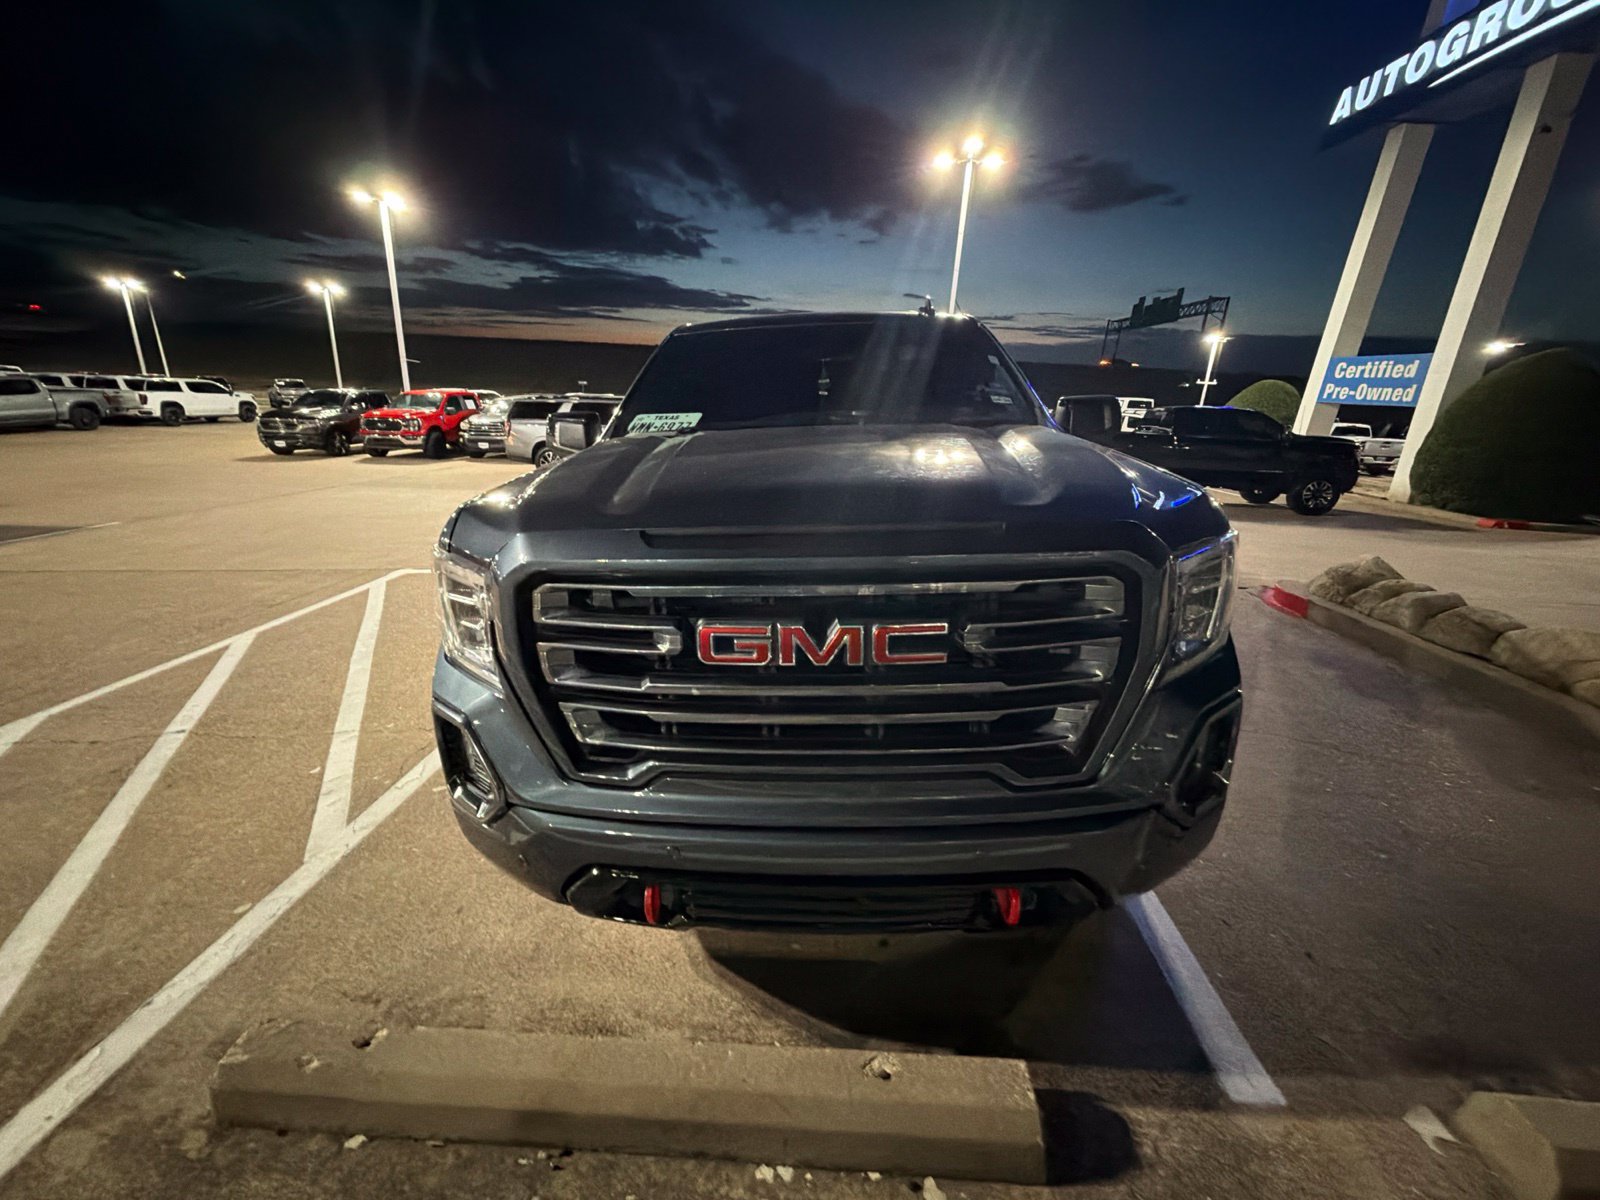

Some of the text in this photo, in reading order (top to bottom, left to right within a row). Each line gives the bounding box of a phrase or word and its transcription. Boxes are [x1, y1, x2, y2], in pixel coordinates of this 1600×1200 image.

[1334, 360, 1420, 379] Certified
[1322, 383, 1418, 402] Pre-Owned
[697, 619, 948, 666] GMC
